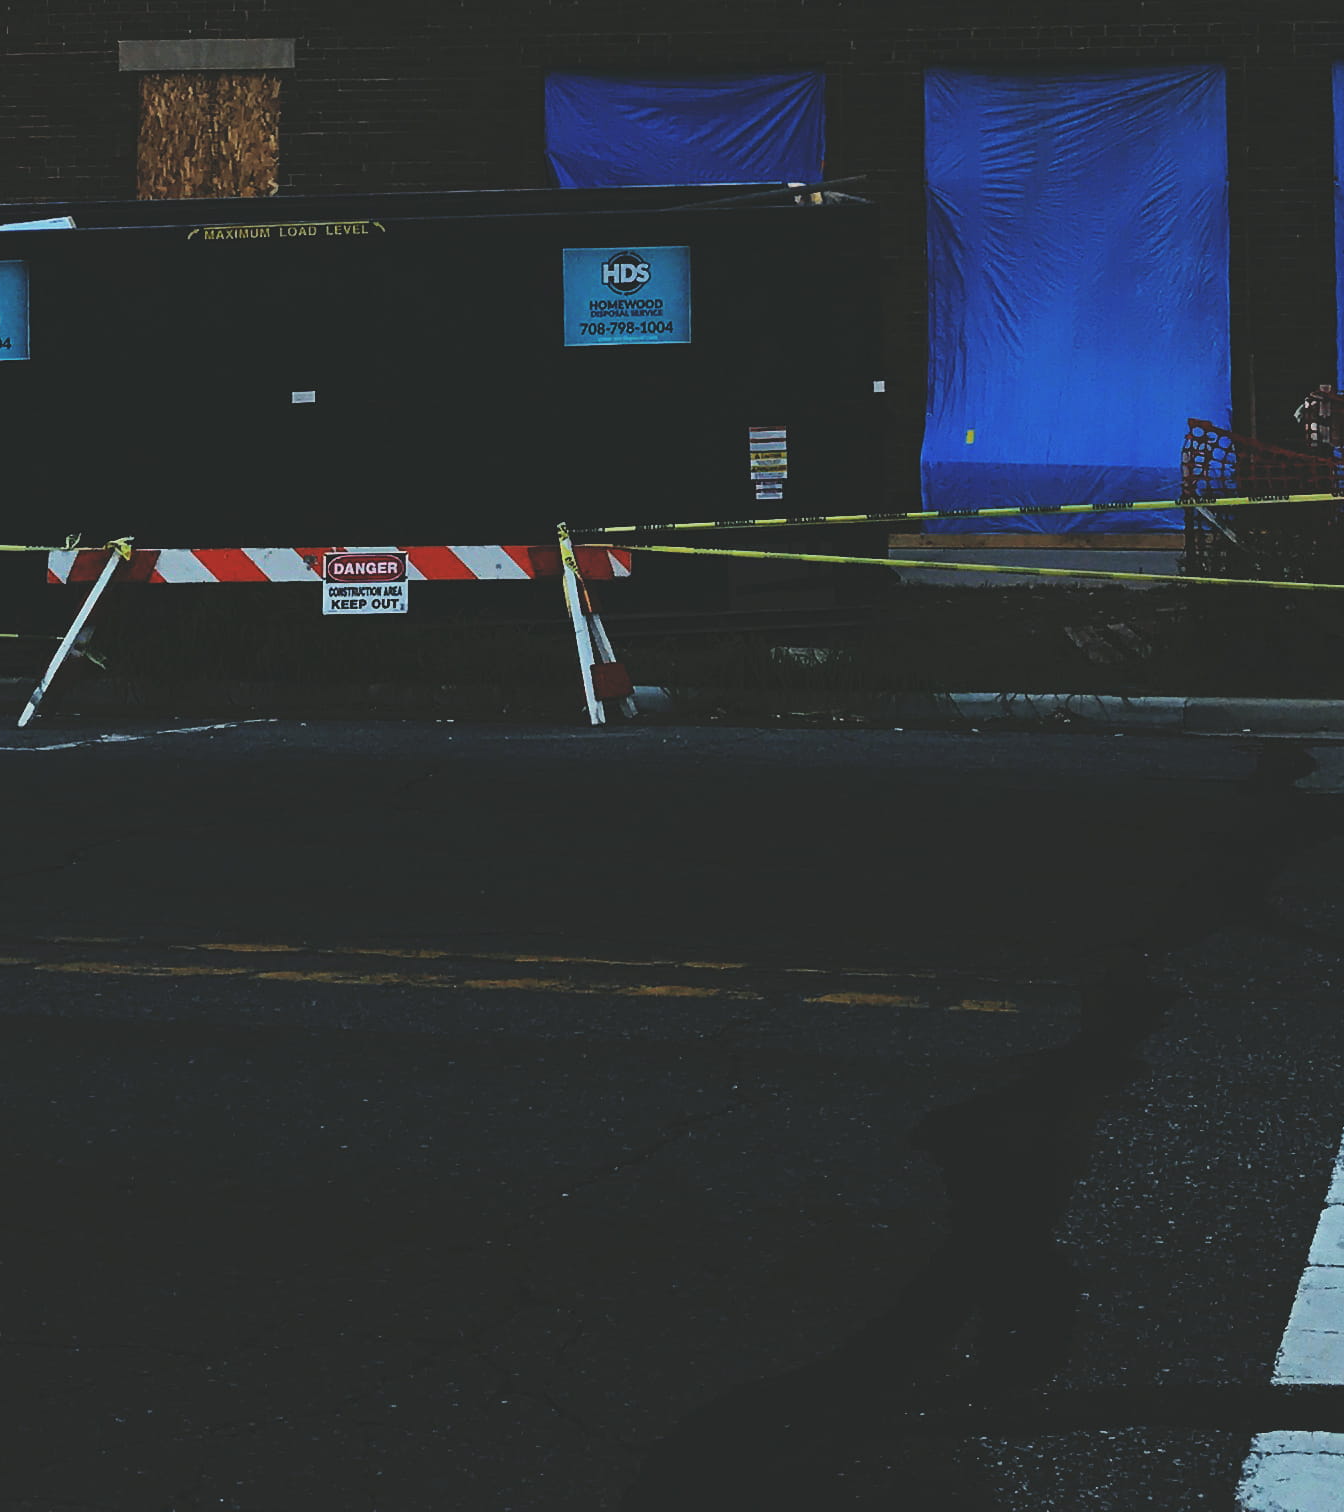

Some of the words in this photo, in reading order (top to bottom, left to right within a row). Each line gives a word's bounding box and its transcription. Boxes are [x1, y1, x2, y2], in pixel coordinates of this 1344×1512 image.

[204, 228, 270, 239] MAXIMUM
[280, 226, 317, 236] LOAD
[326, 224, 369, 235] LEVEL
[602, 263, 650, 284] HDS
[589, 299, 663, 310] HOMEWOOD
[590, 310, 629, 318] DISPOSAL
[631, 309, 663, 317] SERVICE
[579, 321, 673, 335] 708-798-1004
[334, 562, 397, 575] DANGER
[329, 586, 382, 597] CONSTRUCTION
[383, 586, 402, 596] AREA
[331, 599, 367, 610] KEEP
[371, 598, 400, 609] OUT
